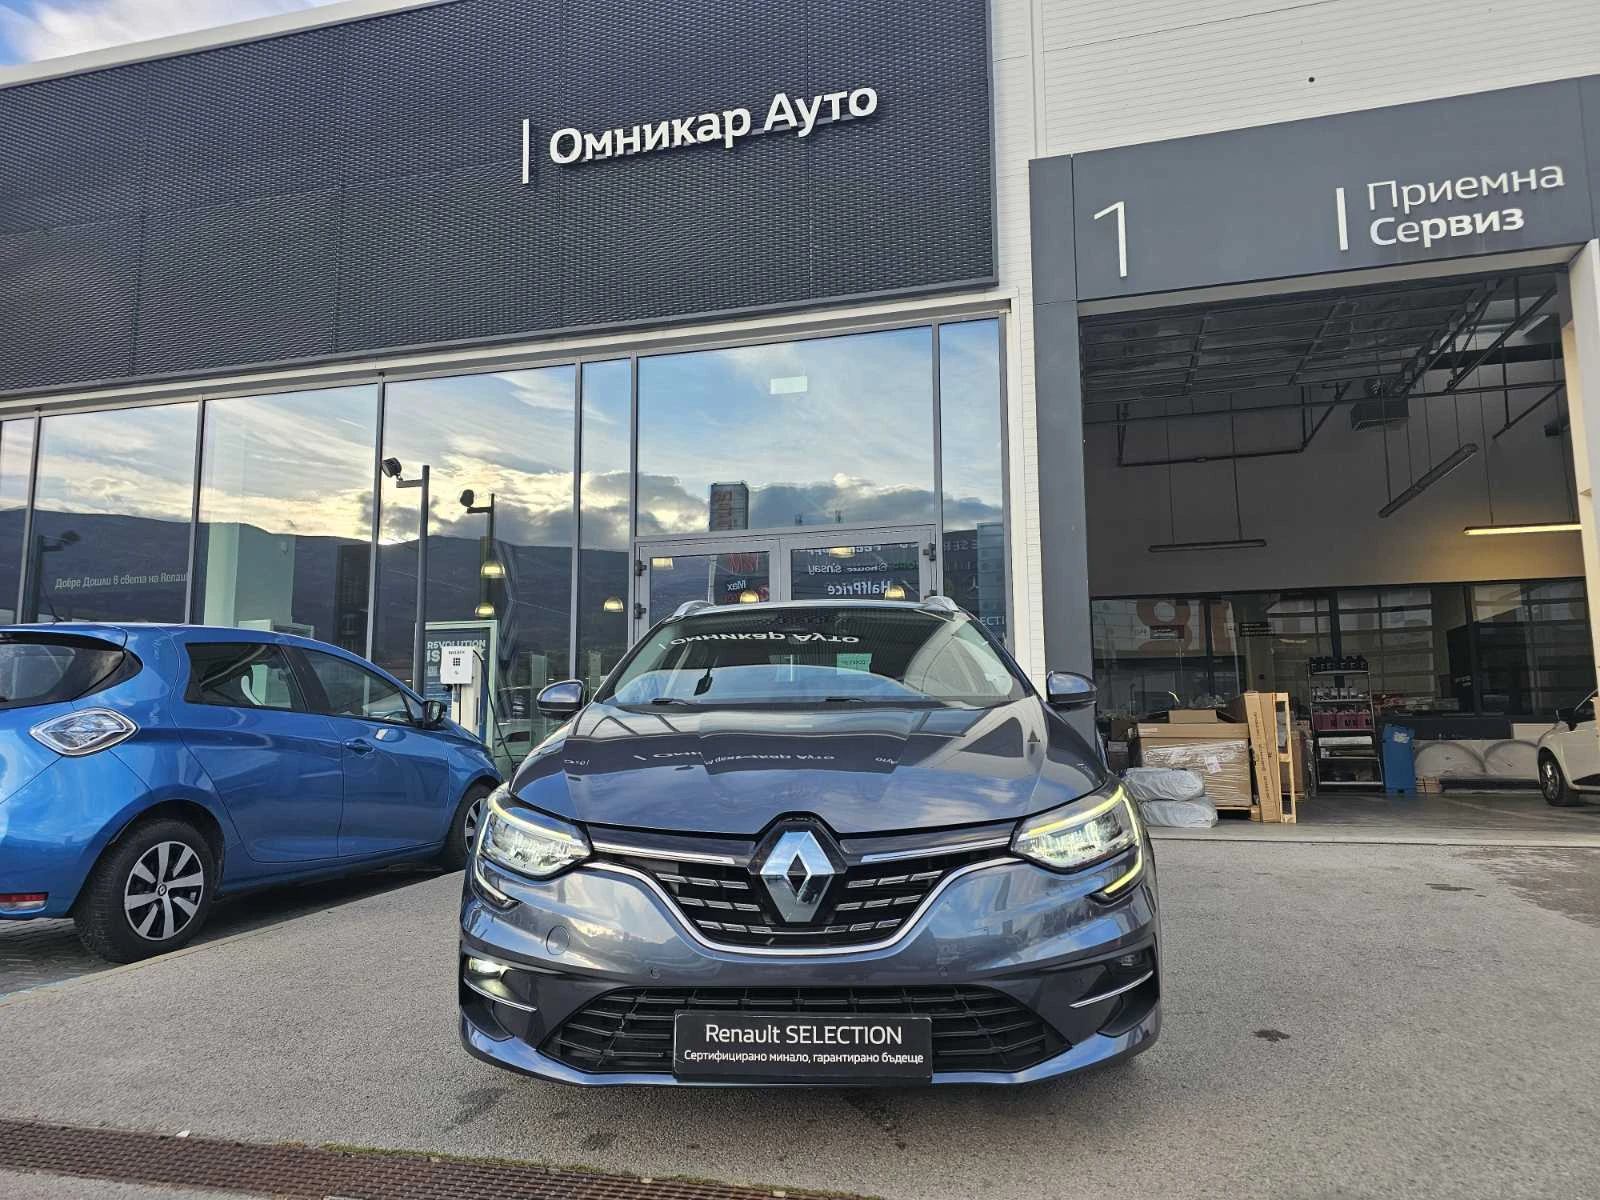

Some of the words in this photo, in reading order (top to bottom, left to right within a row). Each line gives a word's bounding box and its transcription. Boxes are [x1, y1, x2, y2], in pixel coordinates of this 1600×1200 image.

[550, 107, 751, 164] Омникар
[764, 87, 878, 137] Ауто
[1367, 165, 1565, 214] Приемна
[1094, 201, 1128, 278] 1
[1370, 207, 1525, 248] Сервиз
[55, 578, 81, 590] Добре
[83, 575, 112, 587] Дошли
[705, 1024, 780, 1044] Renault
[786, 1026, 902, 1045] SELECTION
[684, 1050, 767, 1063] Сертифицирано
[769, 1052, 811, 1064] минало,
[813, 1052, 880, 1064] гарантирано
[881, 1052, 924, 1064] бъдеще
